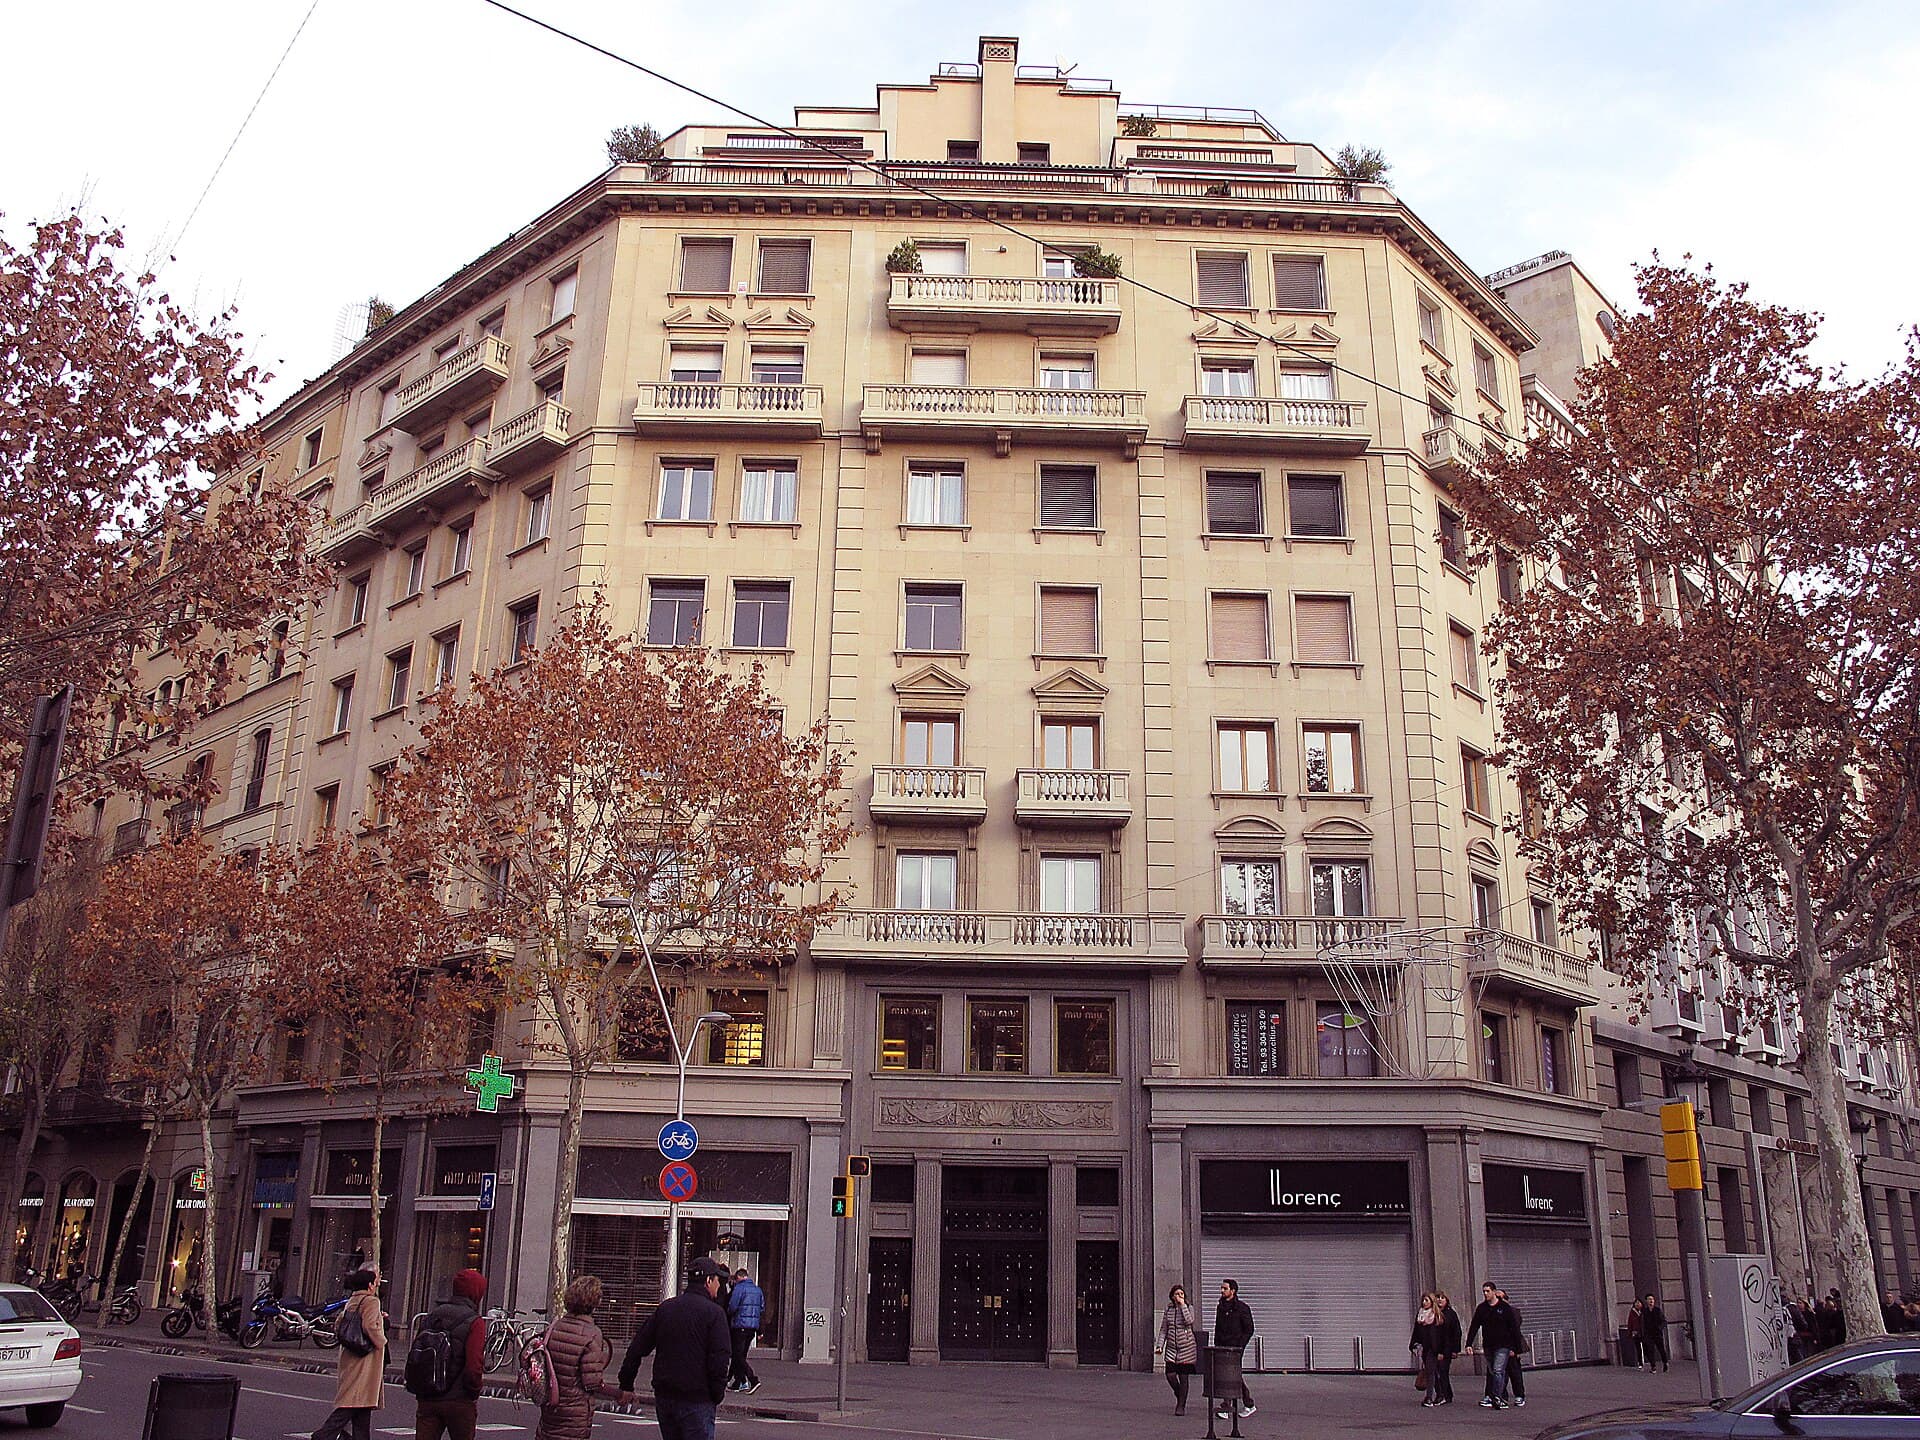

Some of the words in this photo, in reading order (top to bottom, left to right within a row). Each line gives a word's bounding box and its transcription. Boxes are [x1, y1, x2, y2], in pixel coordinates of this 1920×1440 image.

[1259, 1009, 1266, 1019] 09
[1260, 1020, 1267, 1031] 32
[1233, 1013, 1241, 1069] OUTSOURCING
[1241, 1013, 1249, 1069] ENTERPRISE
[1260, 1047, 1268, 1058] 93
[1260, 1059, 1268, 1073] Tel.
[484, 1178, 491, 1192] P
[1270, 1168, 1342, 1208] llorenç
[1523, 1173, 1554, 1213] llorenç
[63, 1198, 78, 1207] PILAR
[175, 1199, 192, 1209] PILAR
